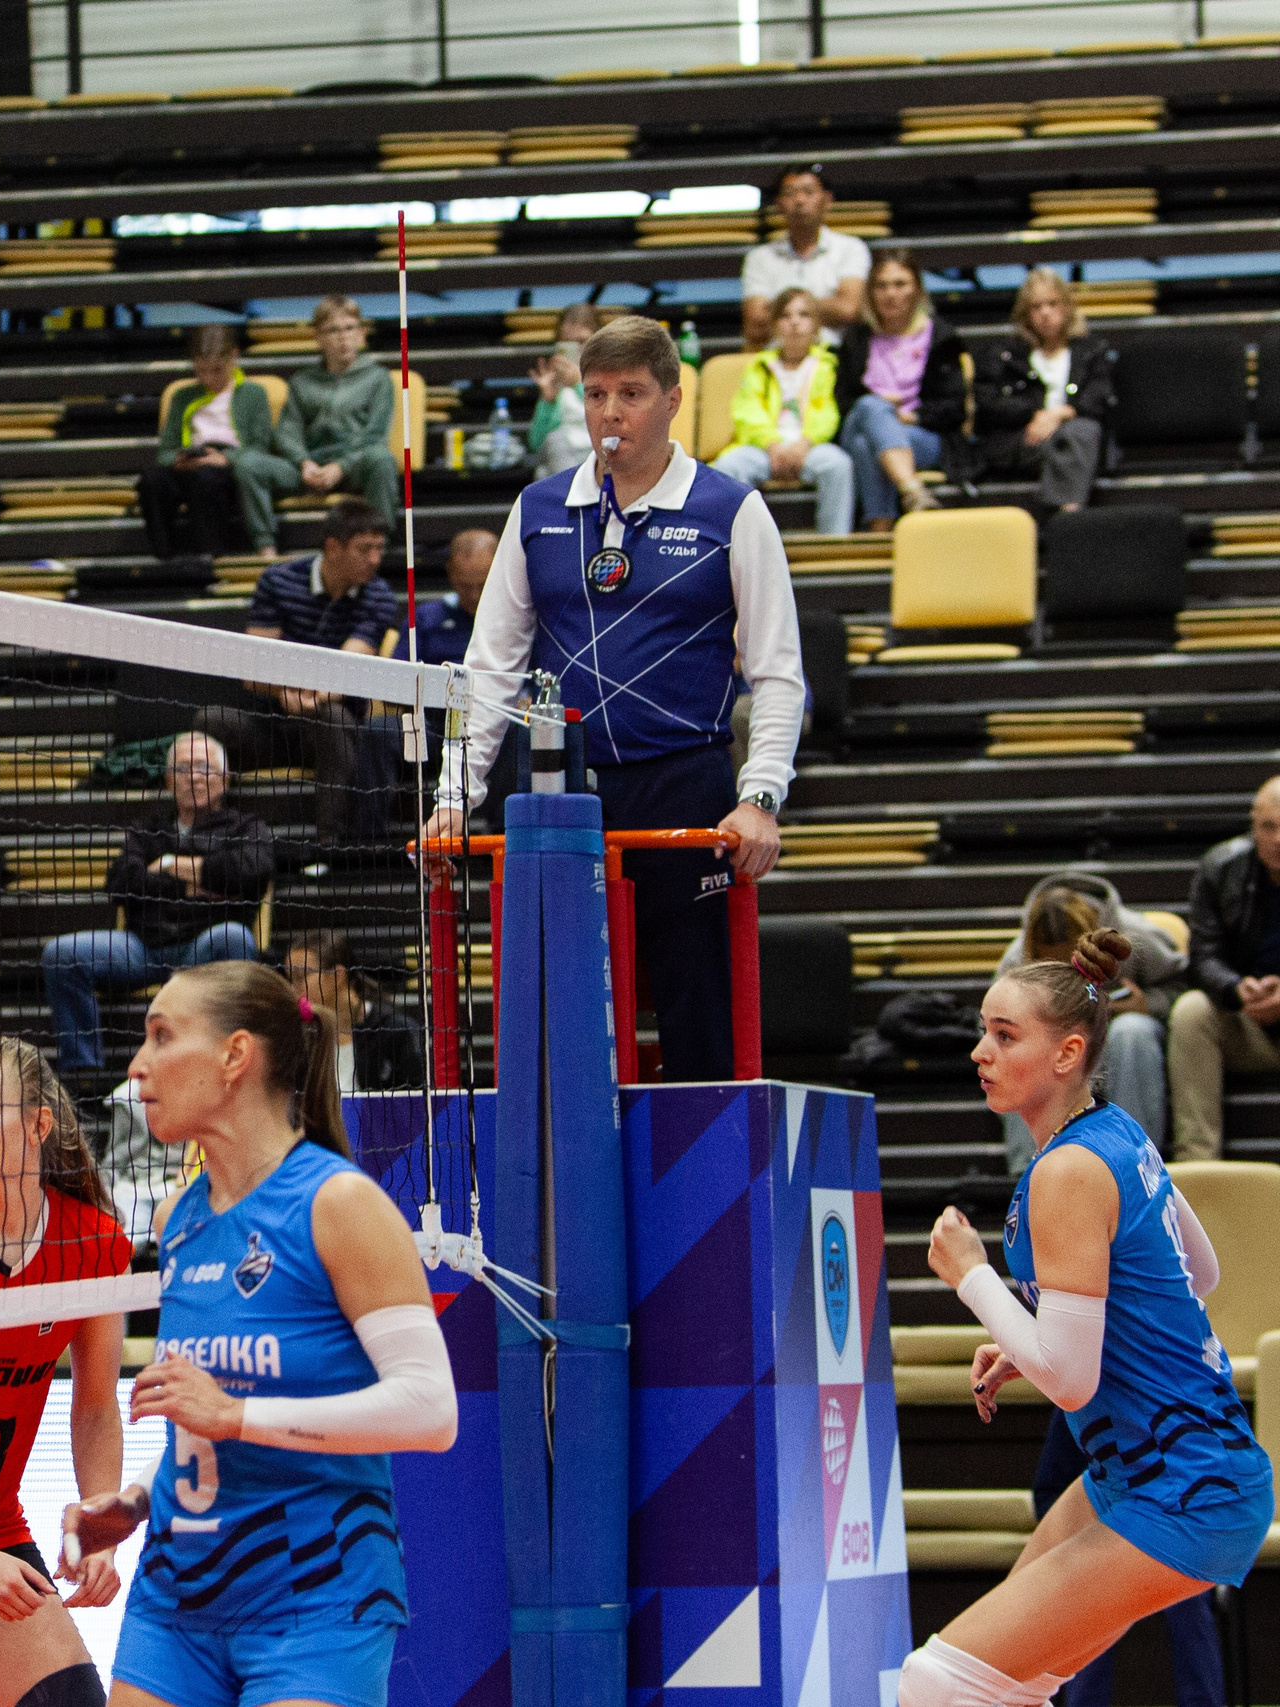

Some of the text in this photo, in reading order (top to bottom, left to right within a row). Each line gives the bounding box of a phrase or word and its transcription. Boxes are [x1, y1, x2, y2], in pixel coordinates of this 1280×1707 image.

[661, 526, 700, 542] ВФВ
[658, 545, 698, 557] СУДЬЯ
[174, 1424, 219, 1514] 5
[842, 1521, 869, 1565] ВФВ
